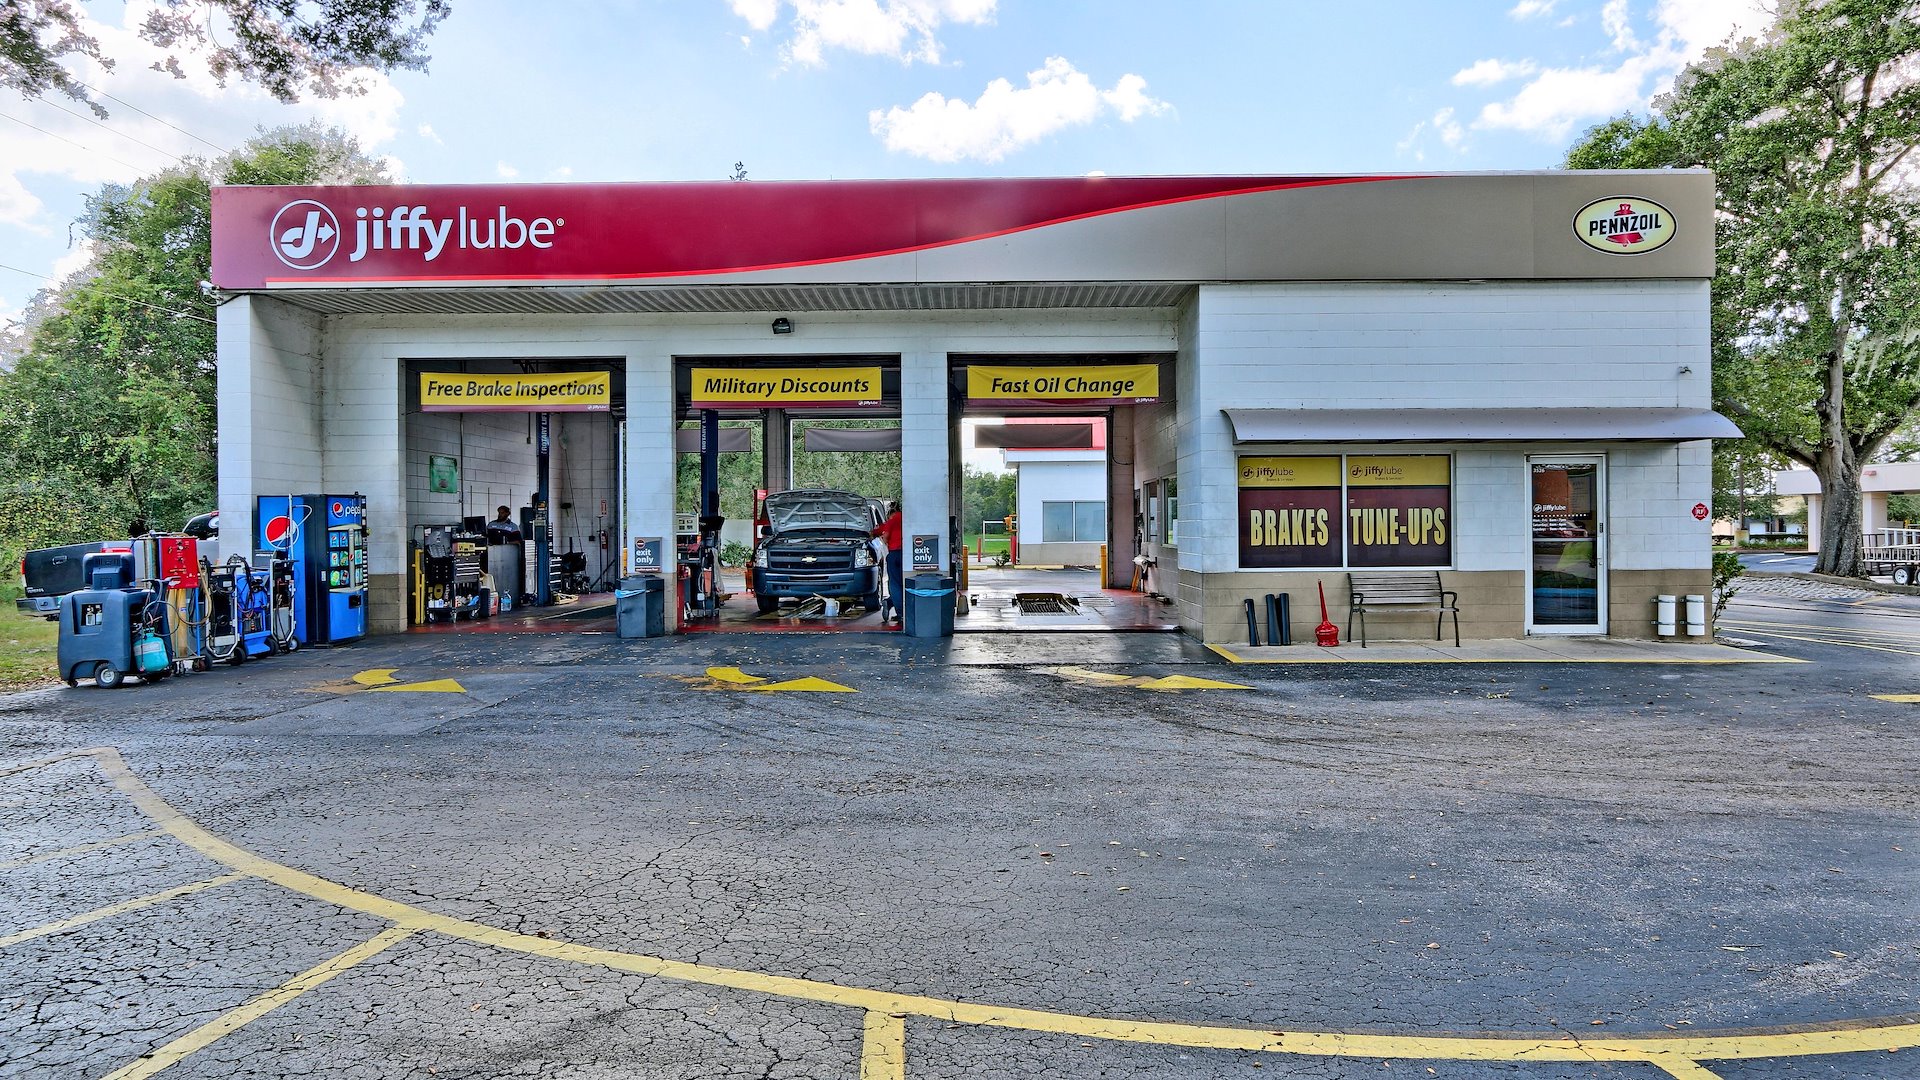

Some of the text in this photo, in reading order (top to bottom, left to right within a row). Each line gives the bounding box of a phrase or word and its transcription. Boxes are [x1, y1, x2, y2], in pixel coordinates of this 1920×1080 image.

[1589, 212, 1662, 236] PENNZOIL
[350, 206, 453, 262] jiffy
[427, 380, 605, 400] Free Brake Inspections
[704, 377, 869, 398] Military Discounts
[991, 377, 1135, 396] Fast Oil Change
[1256, 468, 1274, 478] jiffy
[1365, 466, 1383, 476] jiffy
[1250, 508, 1328, 546] BRAKES
[1350, 507, 1446, 546] TUNE-UPS
[914, 546, 930, 554] exit
[914, 554, 932, 562] only
[636, 556, 654, 564] only
